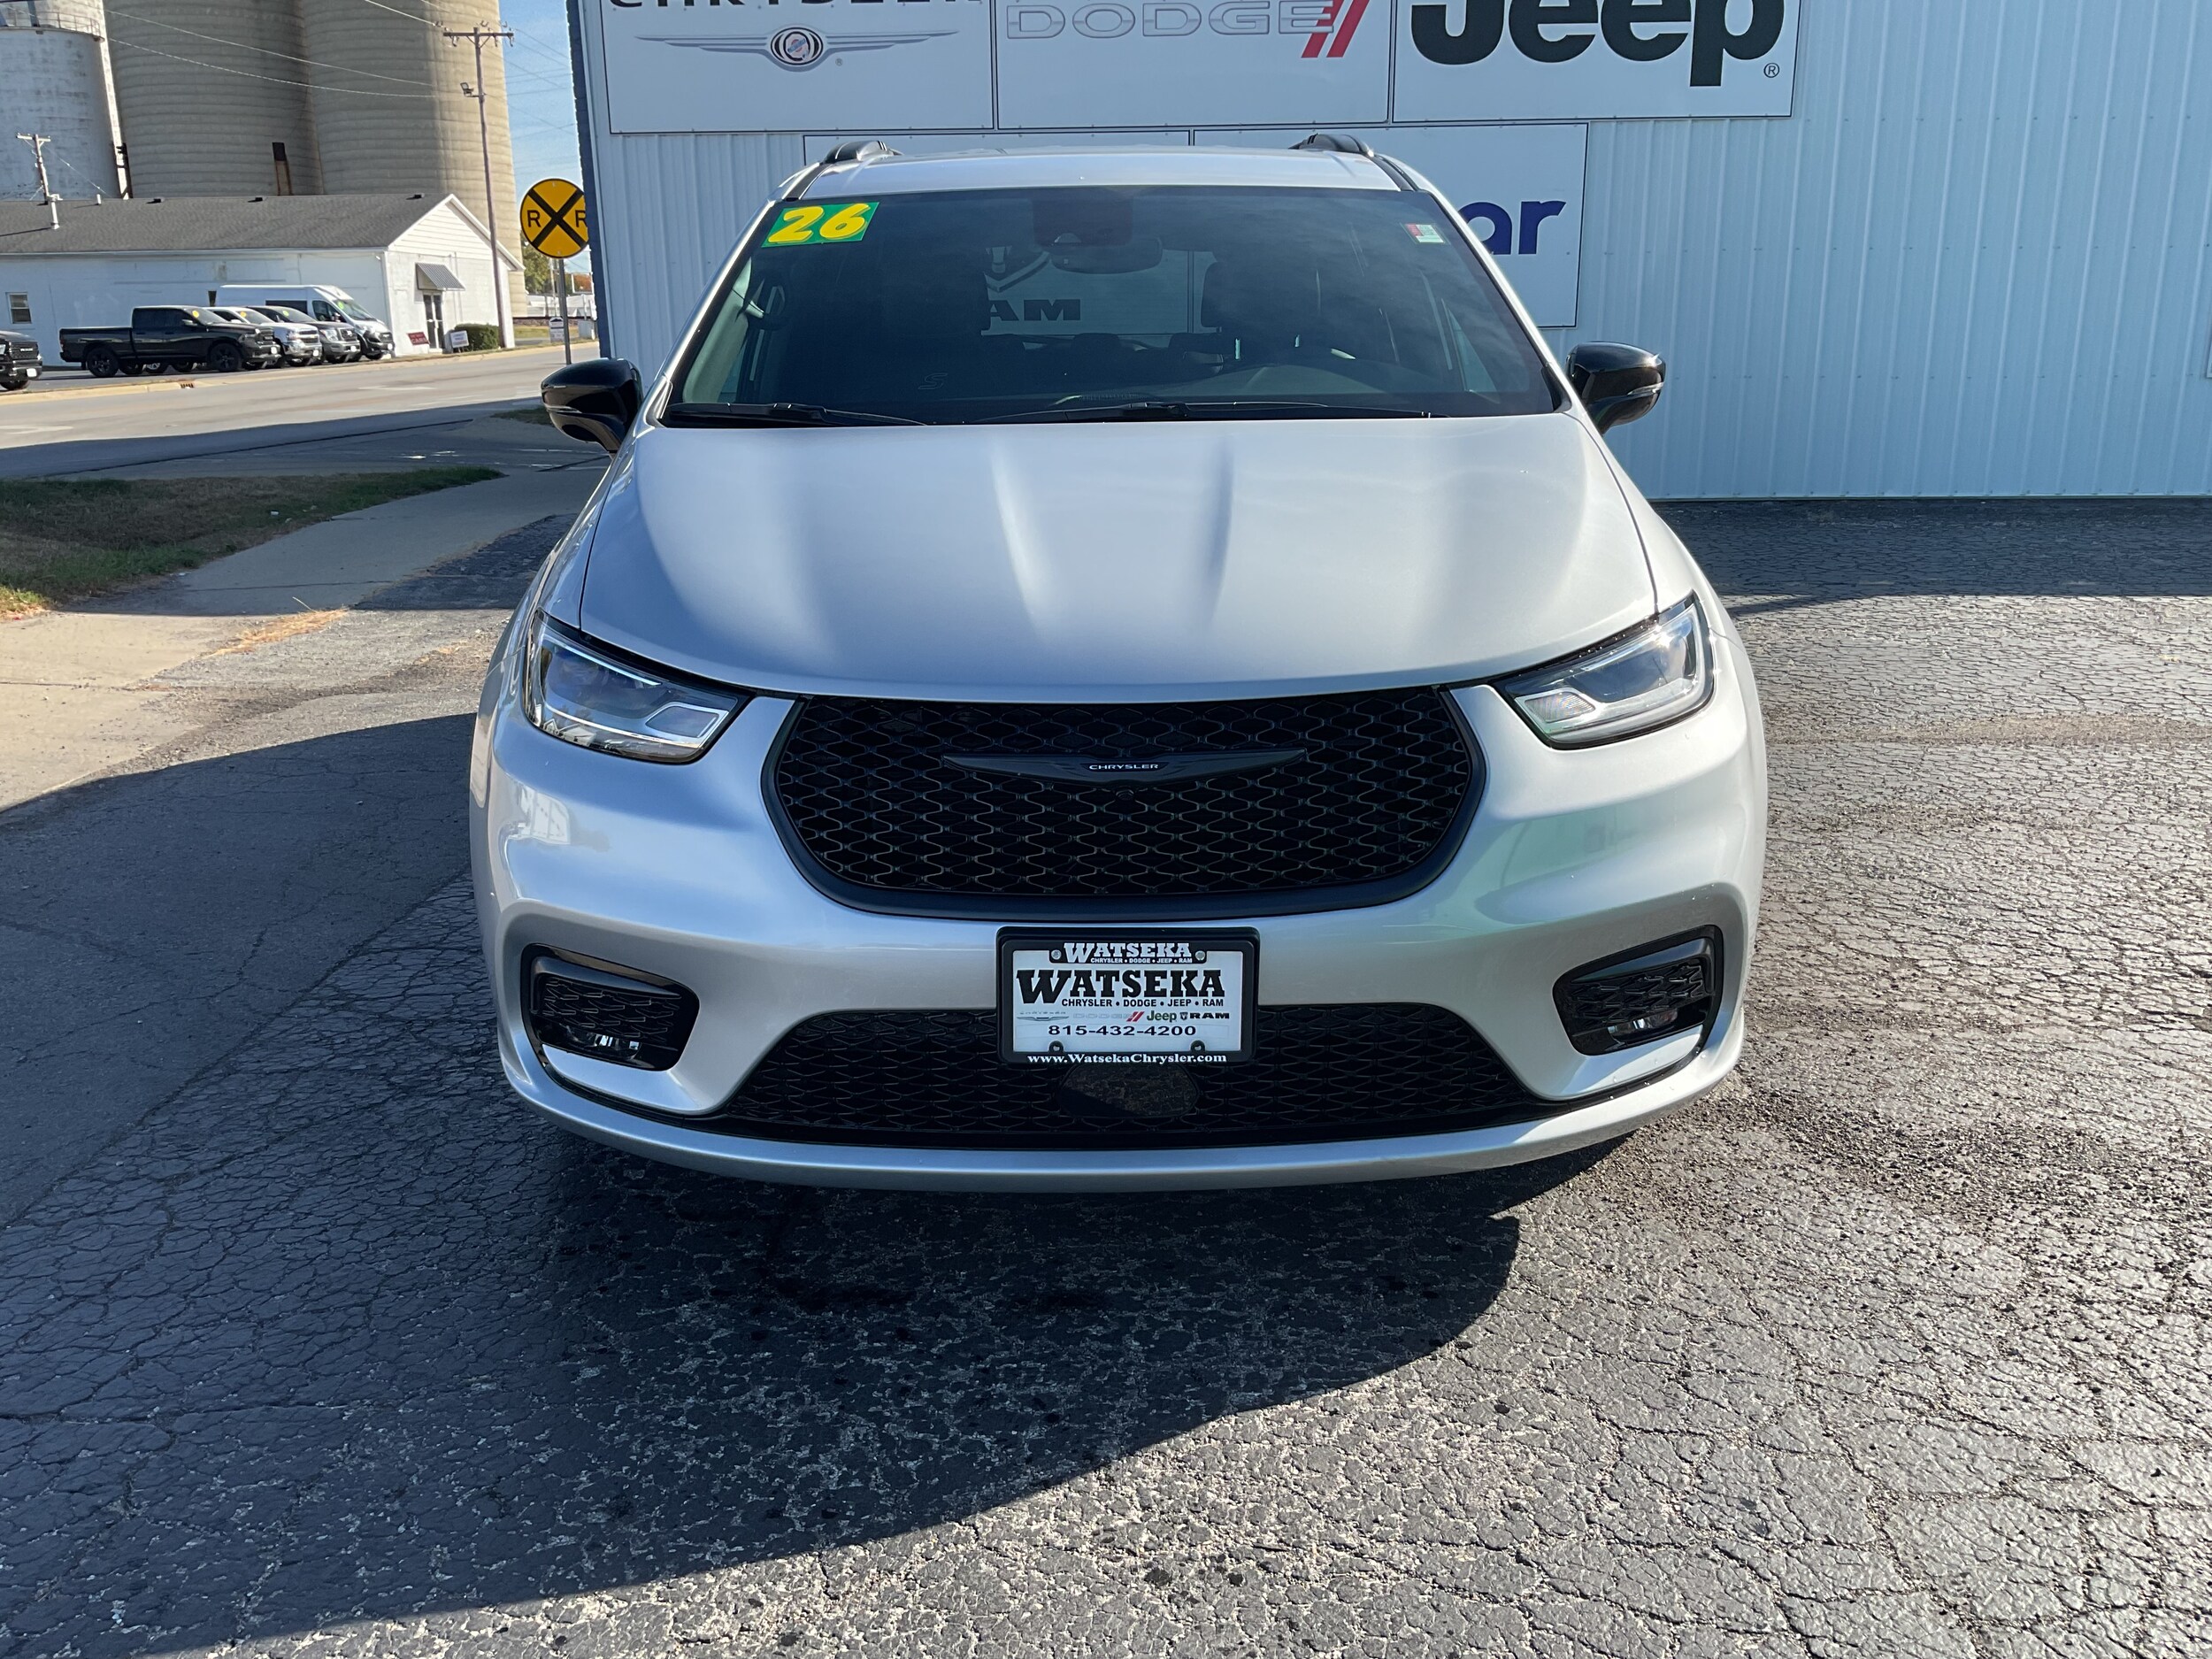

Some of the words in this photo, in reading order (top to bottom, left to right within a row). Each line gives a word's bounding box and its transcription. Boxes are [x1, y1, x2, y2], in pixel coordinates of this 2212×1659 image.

[1006, 1, 1334, 39] DODGE
[1411, 0, 1785, 87] Jeep
[767, 203, 872, 244] 26
[1064, 942, 1192, 964] WATSEKA
[1016, 969, 1225, 1004] WATSEKA
[1061, 998, 1113, 1007] CHRYSLER
[1167, 998, 1192, 1007] JEEP
[1202, 998, 1224, 1007] RAM
[1146, 1010, 1178, 1023] Jeep
[1048, 1025, 1196, 1036] 815-432-4200
[1026, 1053, 1228, 1065] www.WatsekaChrysler.com
